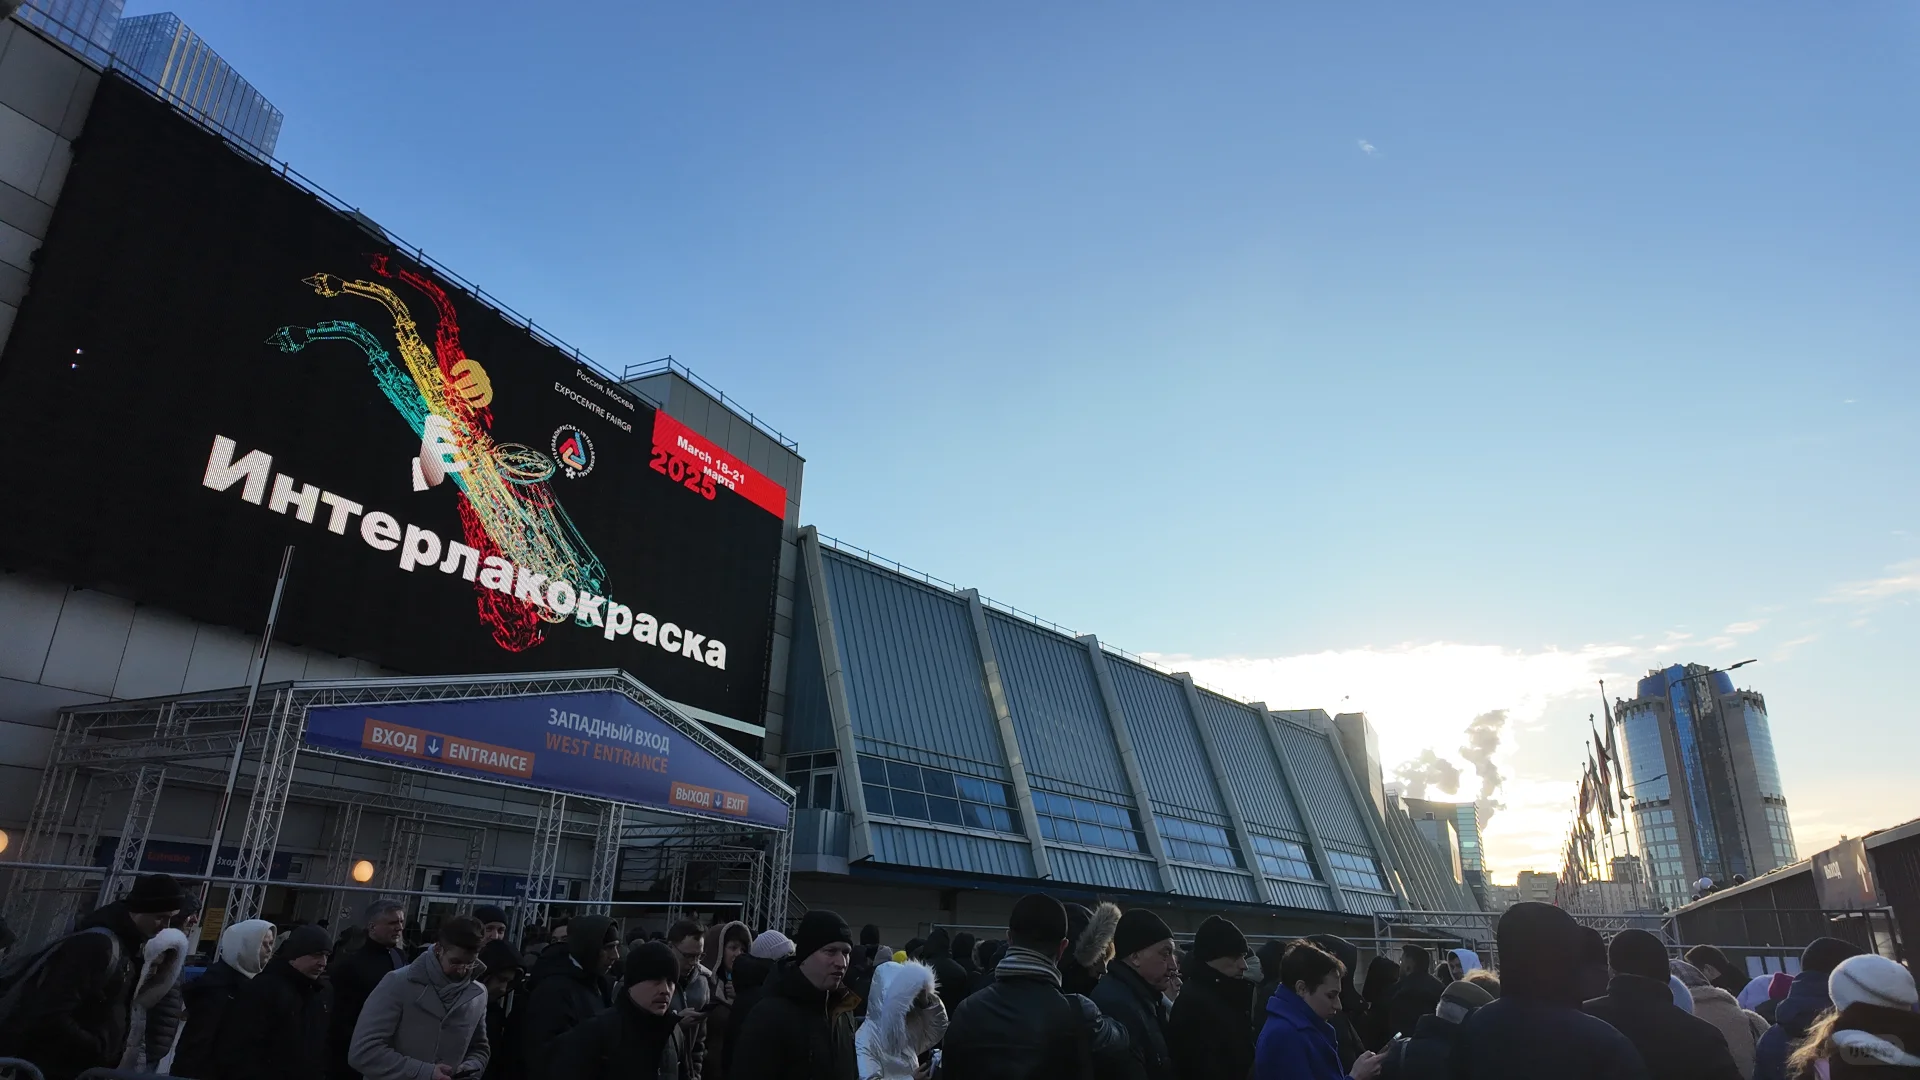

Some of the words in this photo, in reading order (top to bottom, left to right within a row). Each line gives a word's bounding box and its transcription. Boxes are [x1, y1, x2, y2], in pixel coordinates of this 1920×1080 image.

[554, 382, 606, 418] EXPOCENTRE
[677, 435, 712, 464] March
[649, 446, 717, 501] 2025
[703, 465, 736, 491] марта
[203, 434, 728, 671] Интерлакокраска
[371, 727, 418, 754] ВХОД
[547, 708, 633, 743] ЗАПАДНЫЙ
[635, 729, 670, 756] ВХОД
[449, 743, 528, 772] ENTRANCE
[545, 732, 591, 757] WEST
[593, 743, 669, 774] ENTRANCE
[675, 787, 710, 807] ВЫХОД
[726, 797, 745, 811] EXIT
